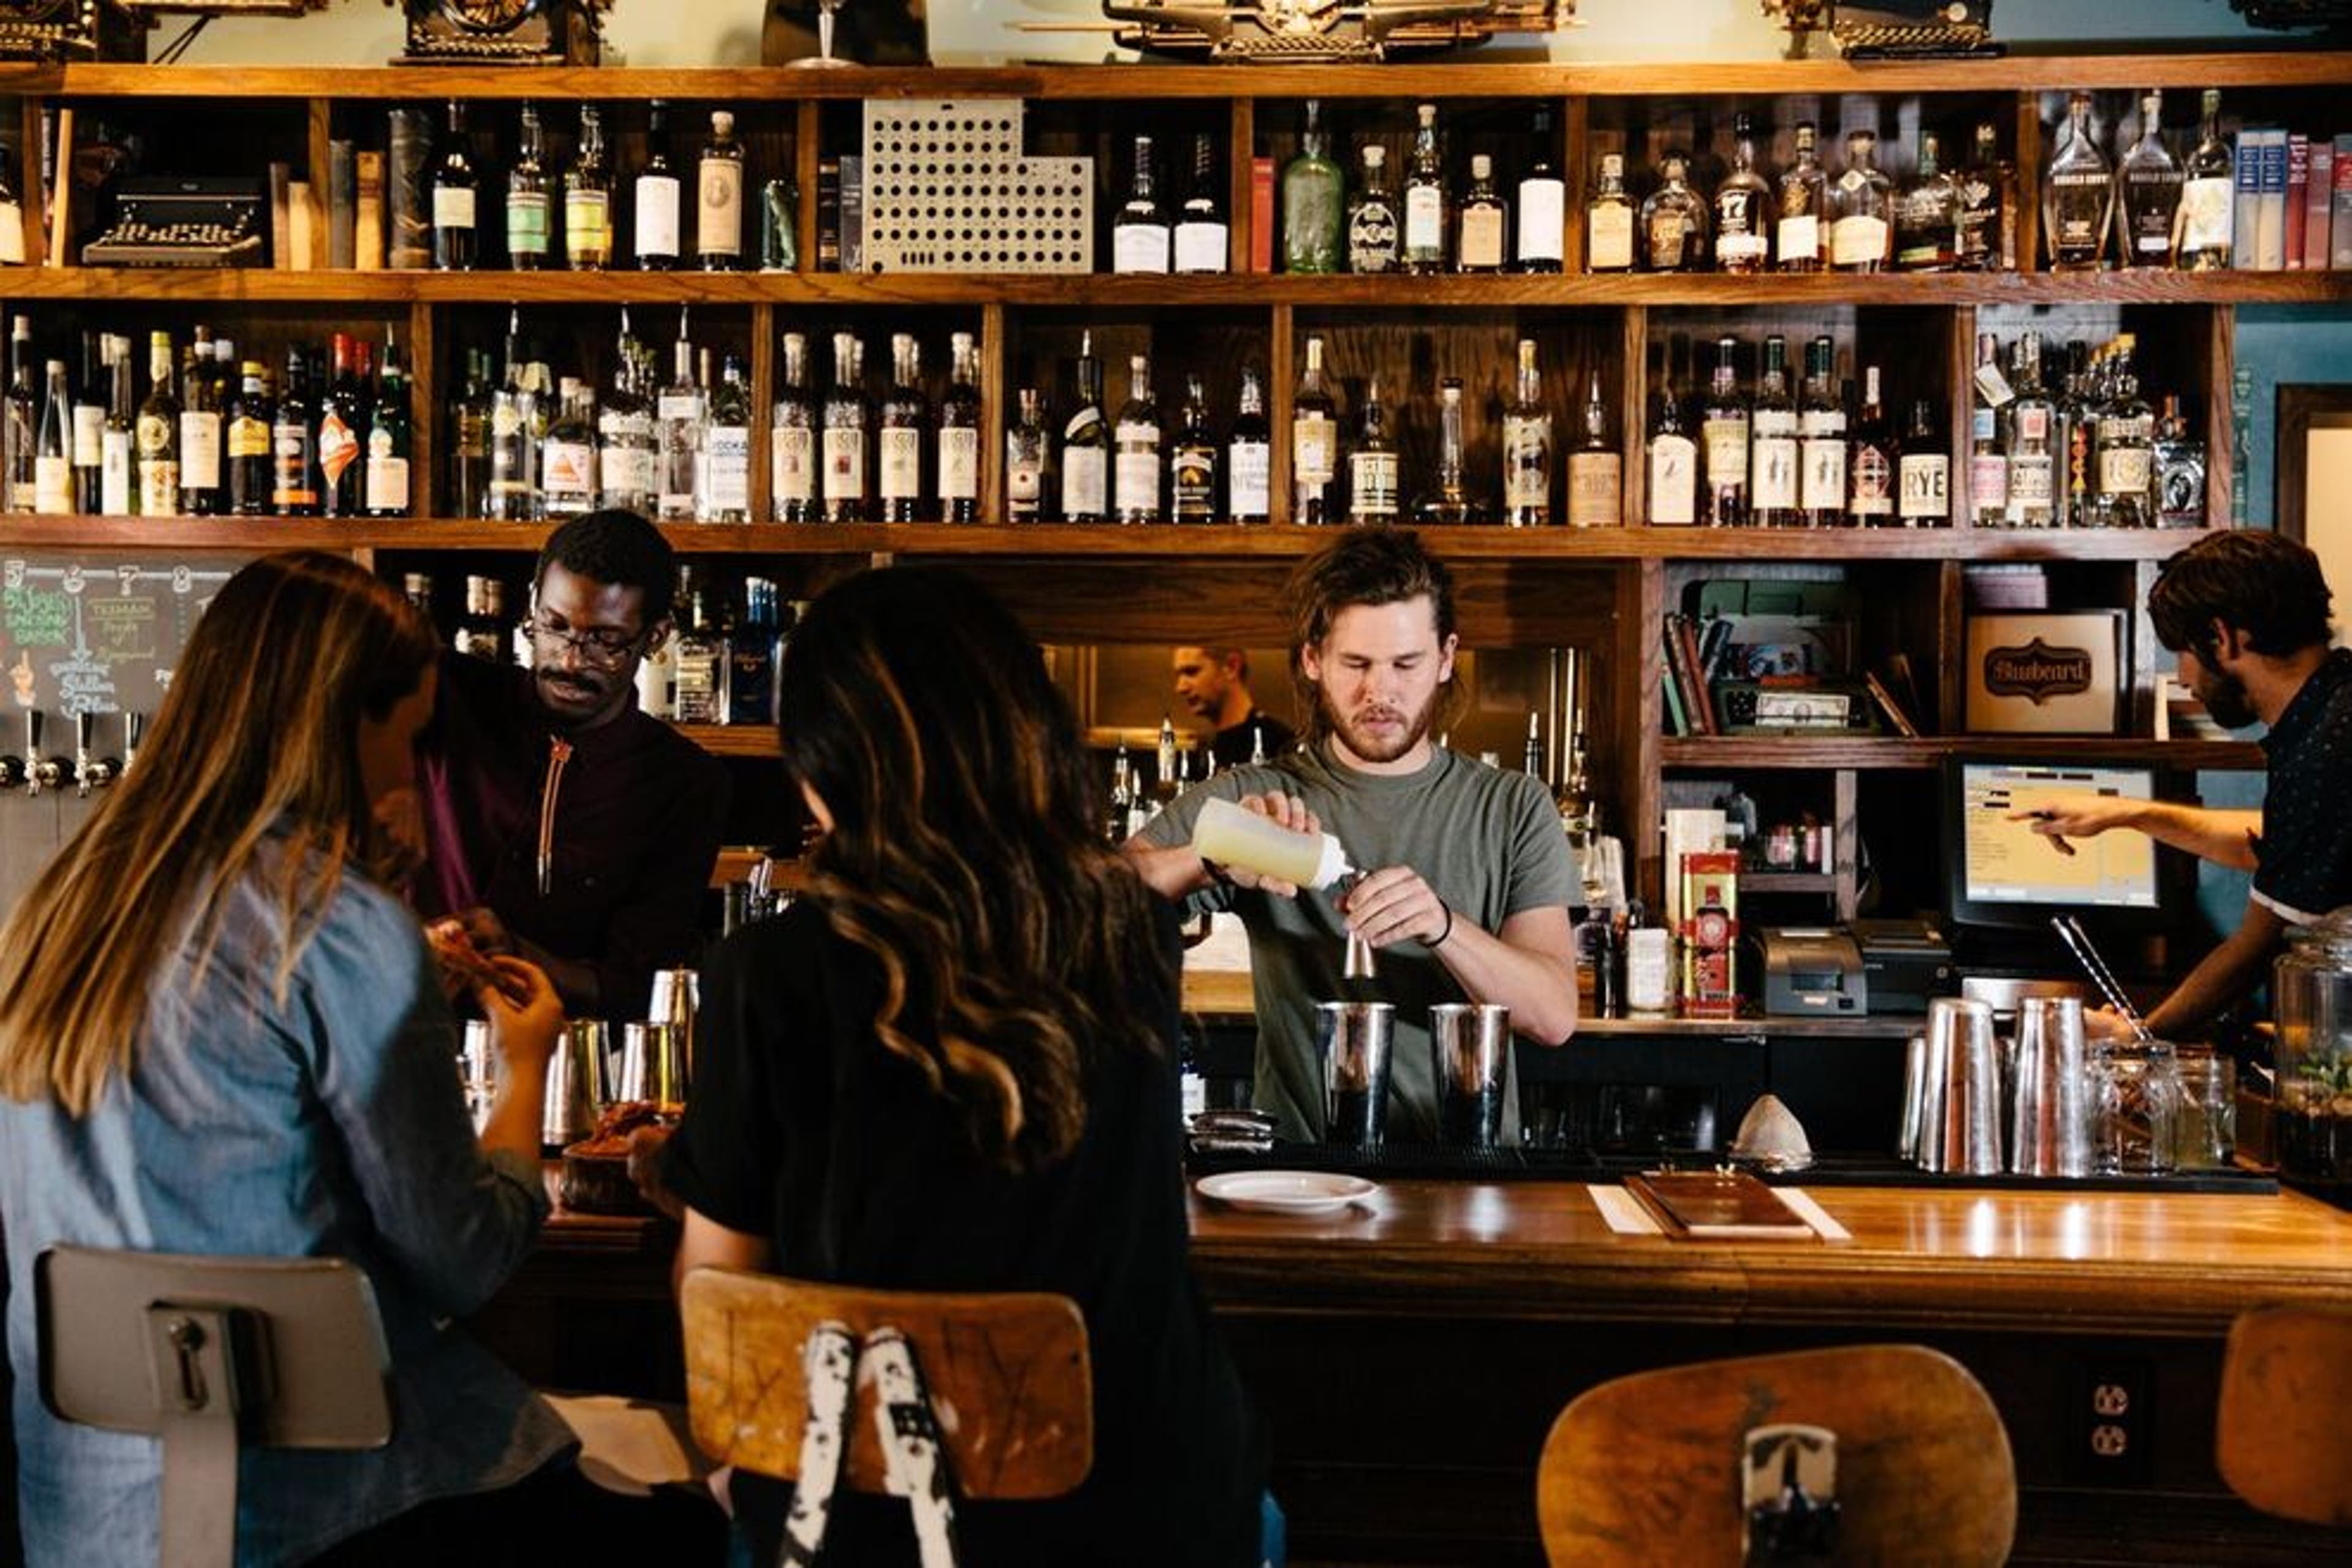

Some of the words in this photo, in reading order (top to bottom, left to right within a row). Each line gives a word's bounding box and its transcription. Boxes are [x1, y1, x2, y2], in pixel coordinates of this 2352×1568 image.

[1905, 470, 1944, 497] RYE
[4, 560, 25, 587] 5
[118, 565, 140, 596] 7
[172, 565, 192, 594] 8
